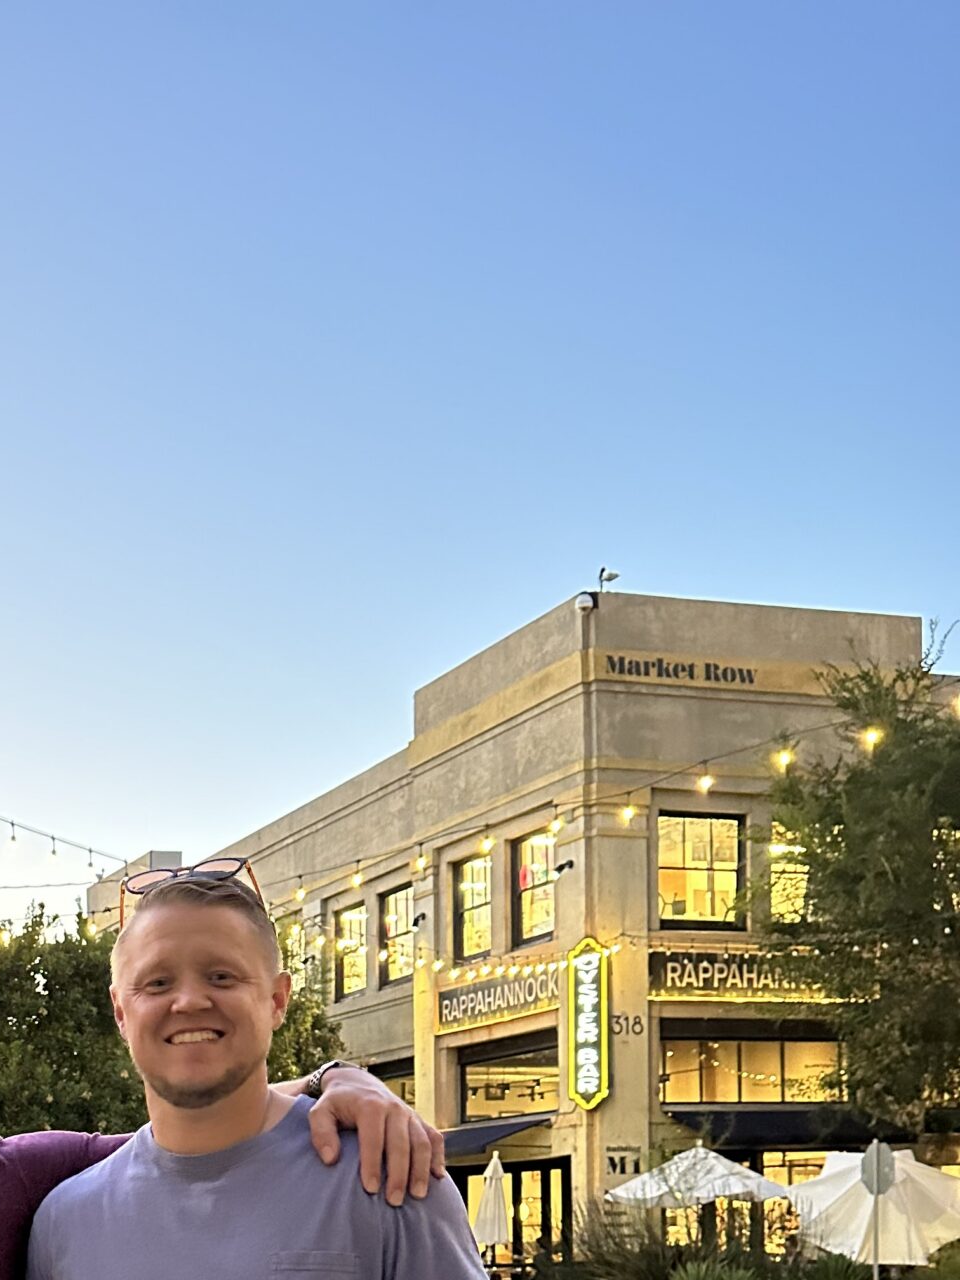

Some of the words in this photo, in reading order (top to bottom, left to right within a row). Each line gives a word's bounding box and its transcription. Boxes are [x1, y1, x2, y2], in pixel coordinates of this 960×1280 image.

[606, 655, 699, 680] Market
[704, 662, 758, 684] Row
[666, 962, 822, 989] RAPPAHA
[442, 972, 559, 1022] RAPPAHANNOCK
[576, 953, 600, 1043] OYSTER
[576, 1047, 600, 1093] BAR
[606, 1156, 641, 1175] M1
